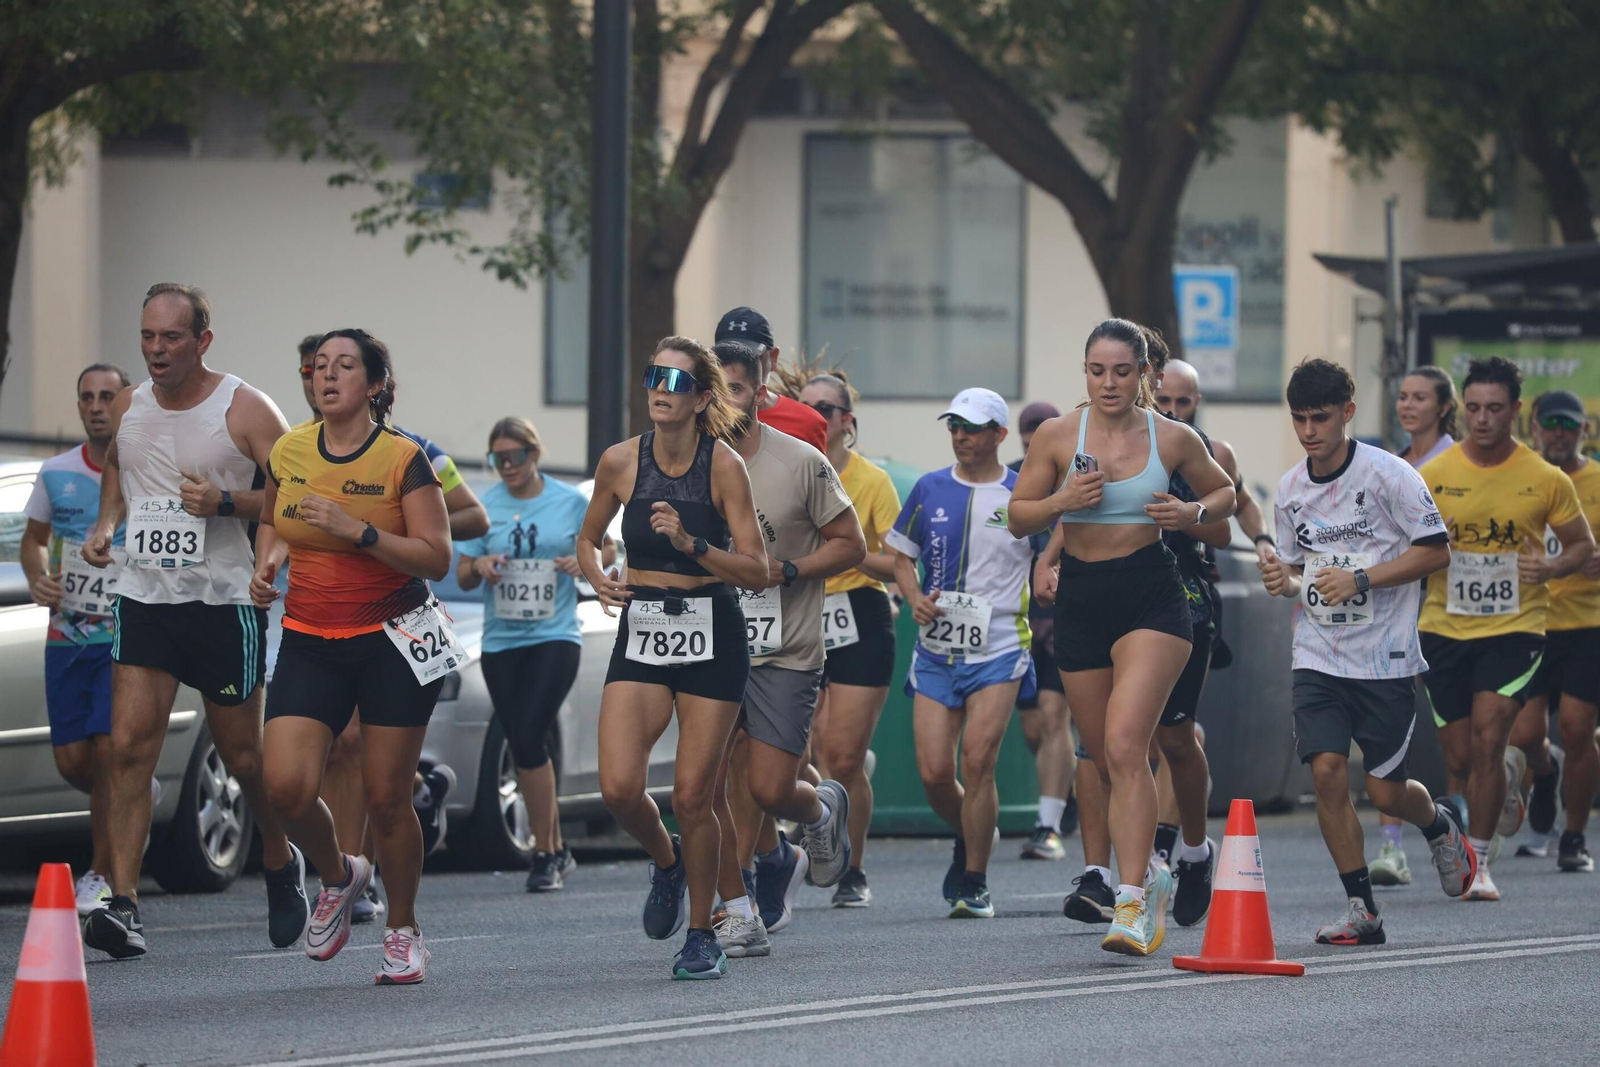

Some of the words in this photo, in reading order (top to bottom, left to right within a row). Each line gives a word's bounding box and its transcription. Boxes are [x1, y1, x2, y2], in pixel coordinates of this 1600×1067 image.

[1180, 279, 1226, 341] P
[290, 476, 306, 485] vive
[763, 521, 776, 542] VIDA
[1316, 519, 1367, 536] standard
[1318, 528, 1373, 544] chartered
[134, 530, 197, 555] 1883
[499, 583, 553, 600] 10218
[1455, 580, 1513, 602] 1648
[640, 603, 663, 614] 45
[746, 617, 775, 641] 57
[925, 619, 982, 647] 2218
[637, 630, 706, 657] 7820
